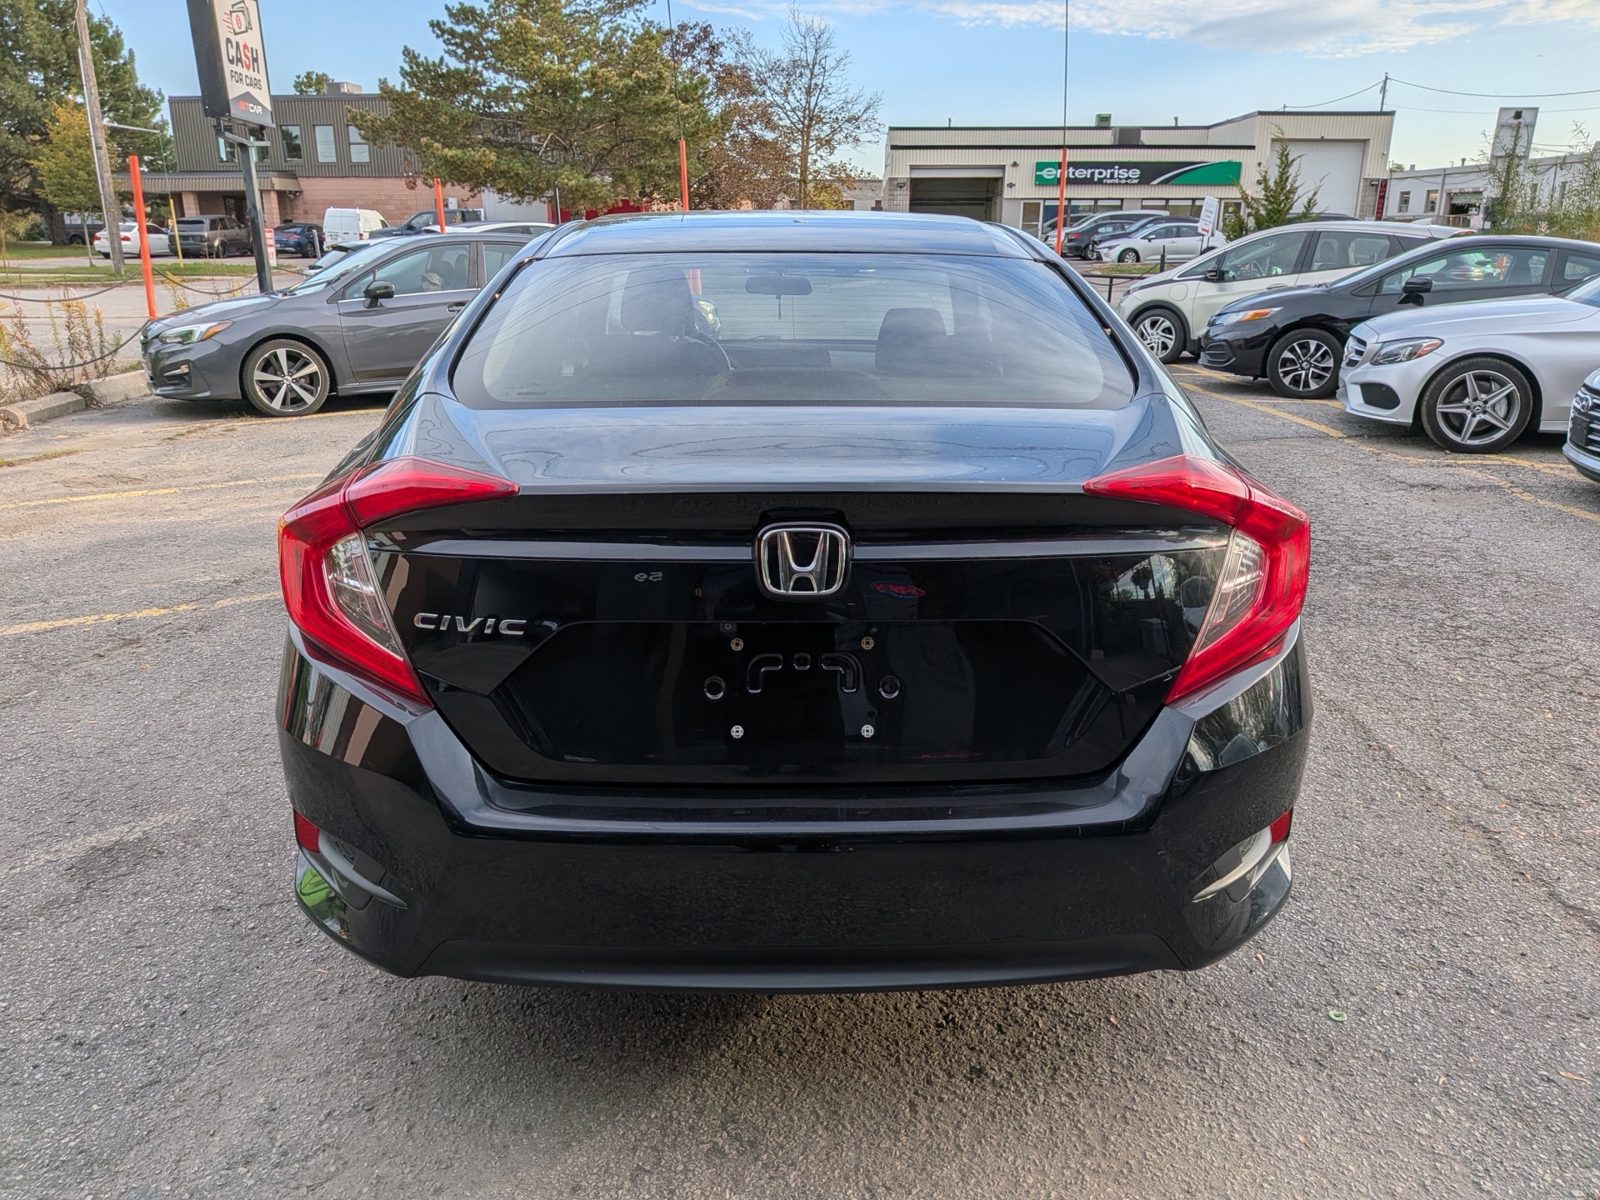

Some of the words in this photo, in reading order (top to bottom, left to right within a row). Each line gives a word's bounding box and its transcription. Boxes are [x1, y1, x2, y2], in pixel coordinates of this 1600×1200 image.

[230, 69, 244, 86] FOR
[244, 74, 263, 91] CARS
[413, 612, 527, 635] CIVIC
